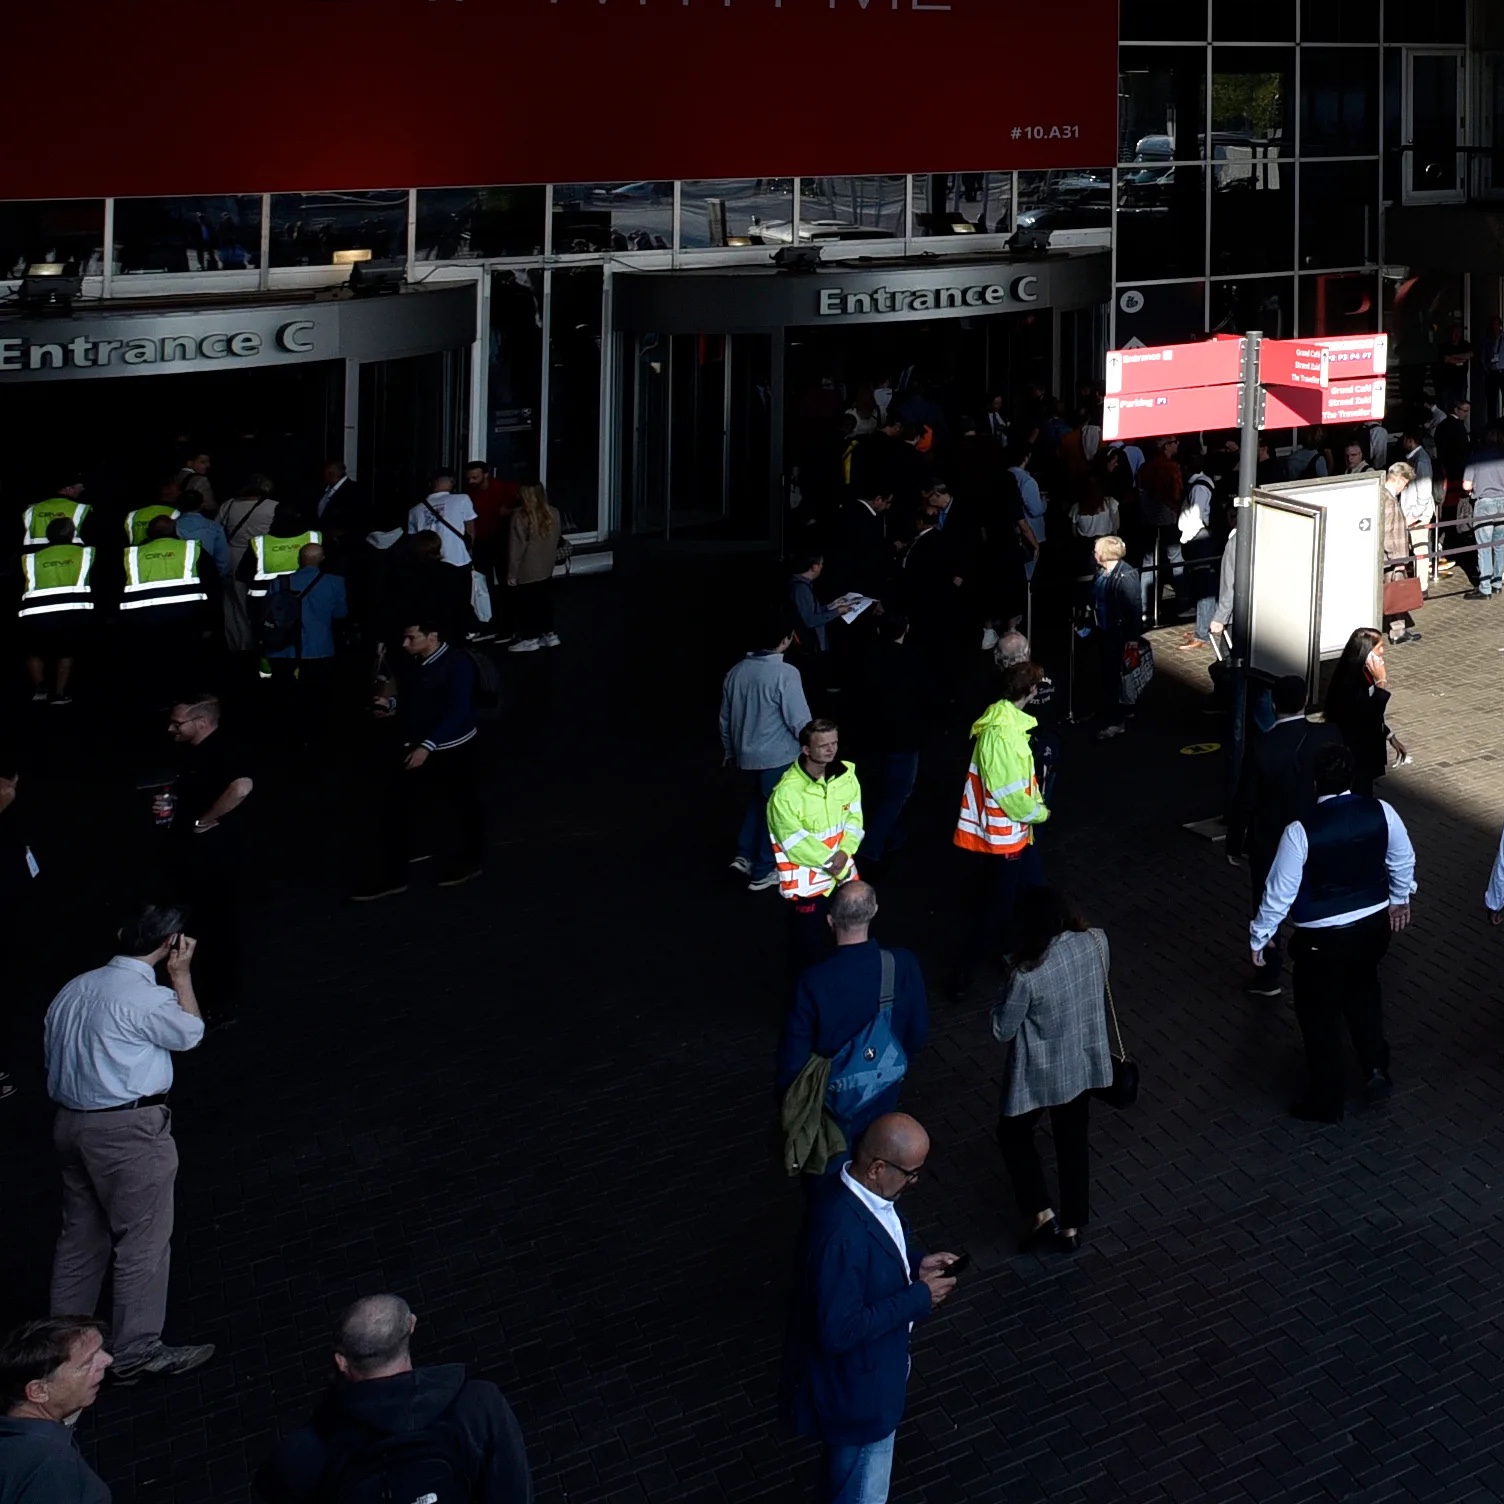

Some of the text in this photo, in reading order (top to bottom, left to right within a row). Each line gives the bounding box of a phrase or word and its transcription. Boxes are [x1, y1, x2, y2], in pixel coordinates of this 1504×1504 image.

[1011, 123, 1081, 141] #10.A31
[820, 276, 1039, 316] Entrance C
[0, 320, 316, 371] Entrance C
[1120, 398, 1153, 409] Parking
